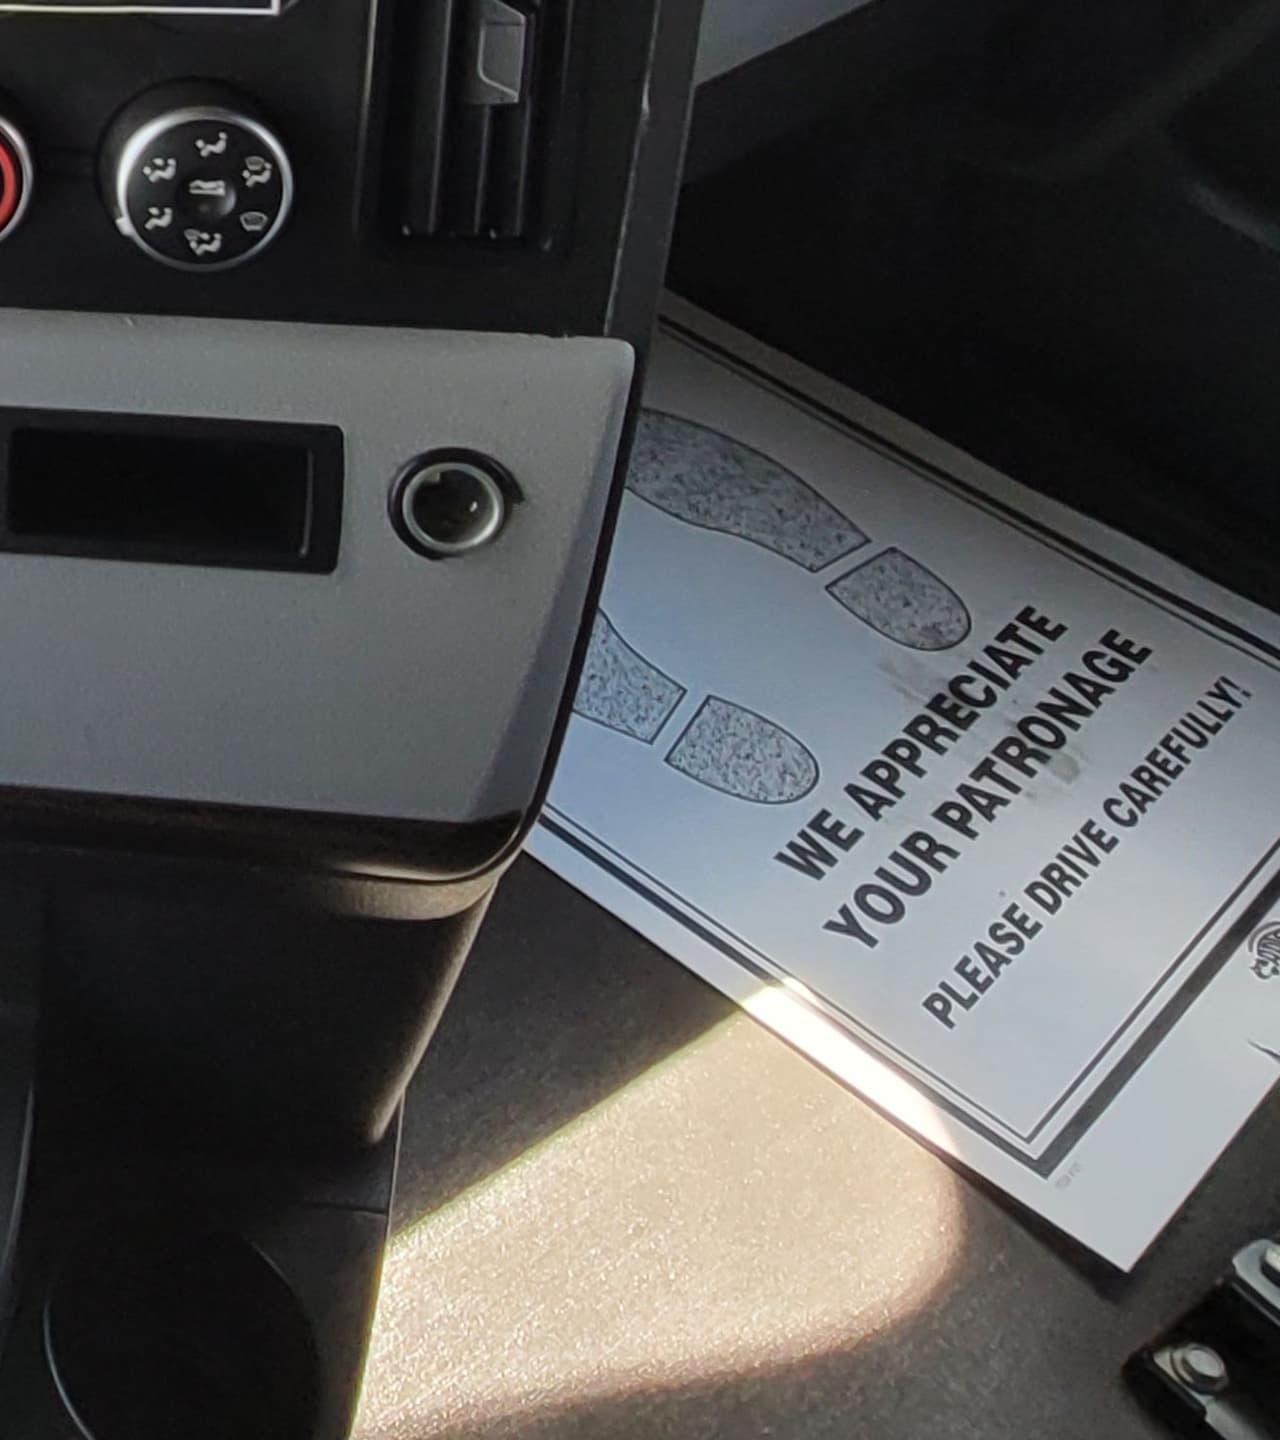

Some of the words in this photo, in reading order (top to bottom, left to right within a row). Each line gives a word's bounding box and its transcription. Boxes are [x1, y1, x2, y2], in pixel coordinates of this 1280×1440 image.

[773, 808, 866, 882] WE
[843, 605, 1069, 822] APPRECIATE
[822, 830, 962, 951] YOUR
[931, 628, 1153, 842] PATRONAGE
[921, 902, 1044, 1031] PLEASE
[1024, 818, 1120, 917] DRIVE
[1102, 675, 1253, 830] CAREFULLY!
